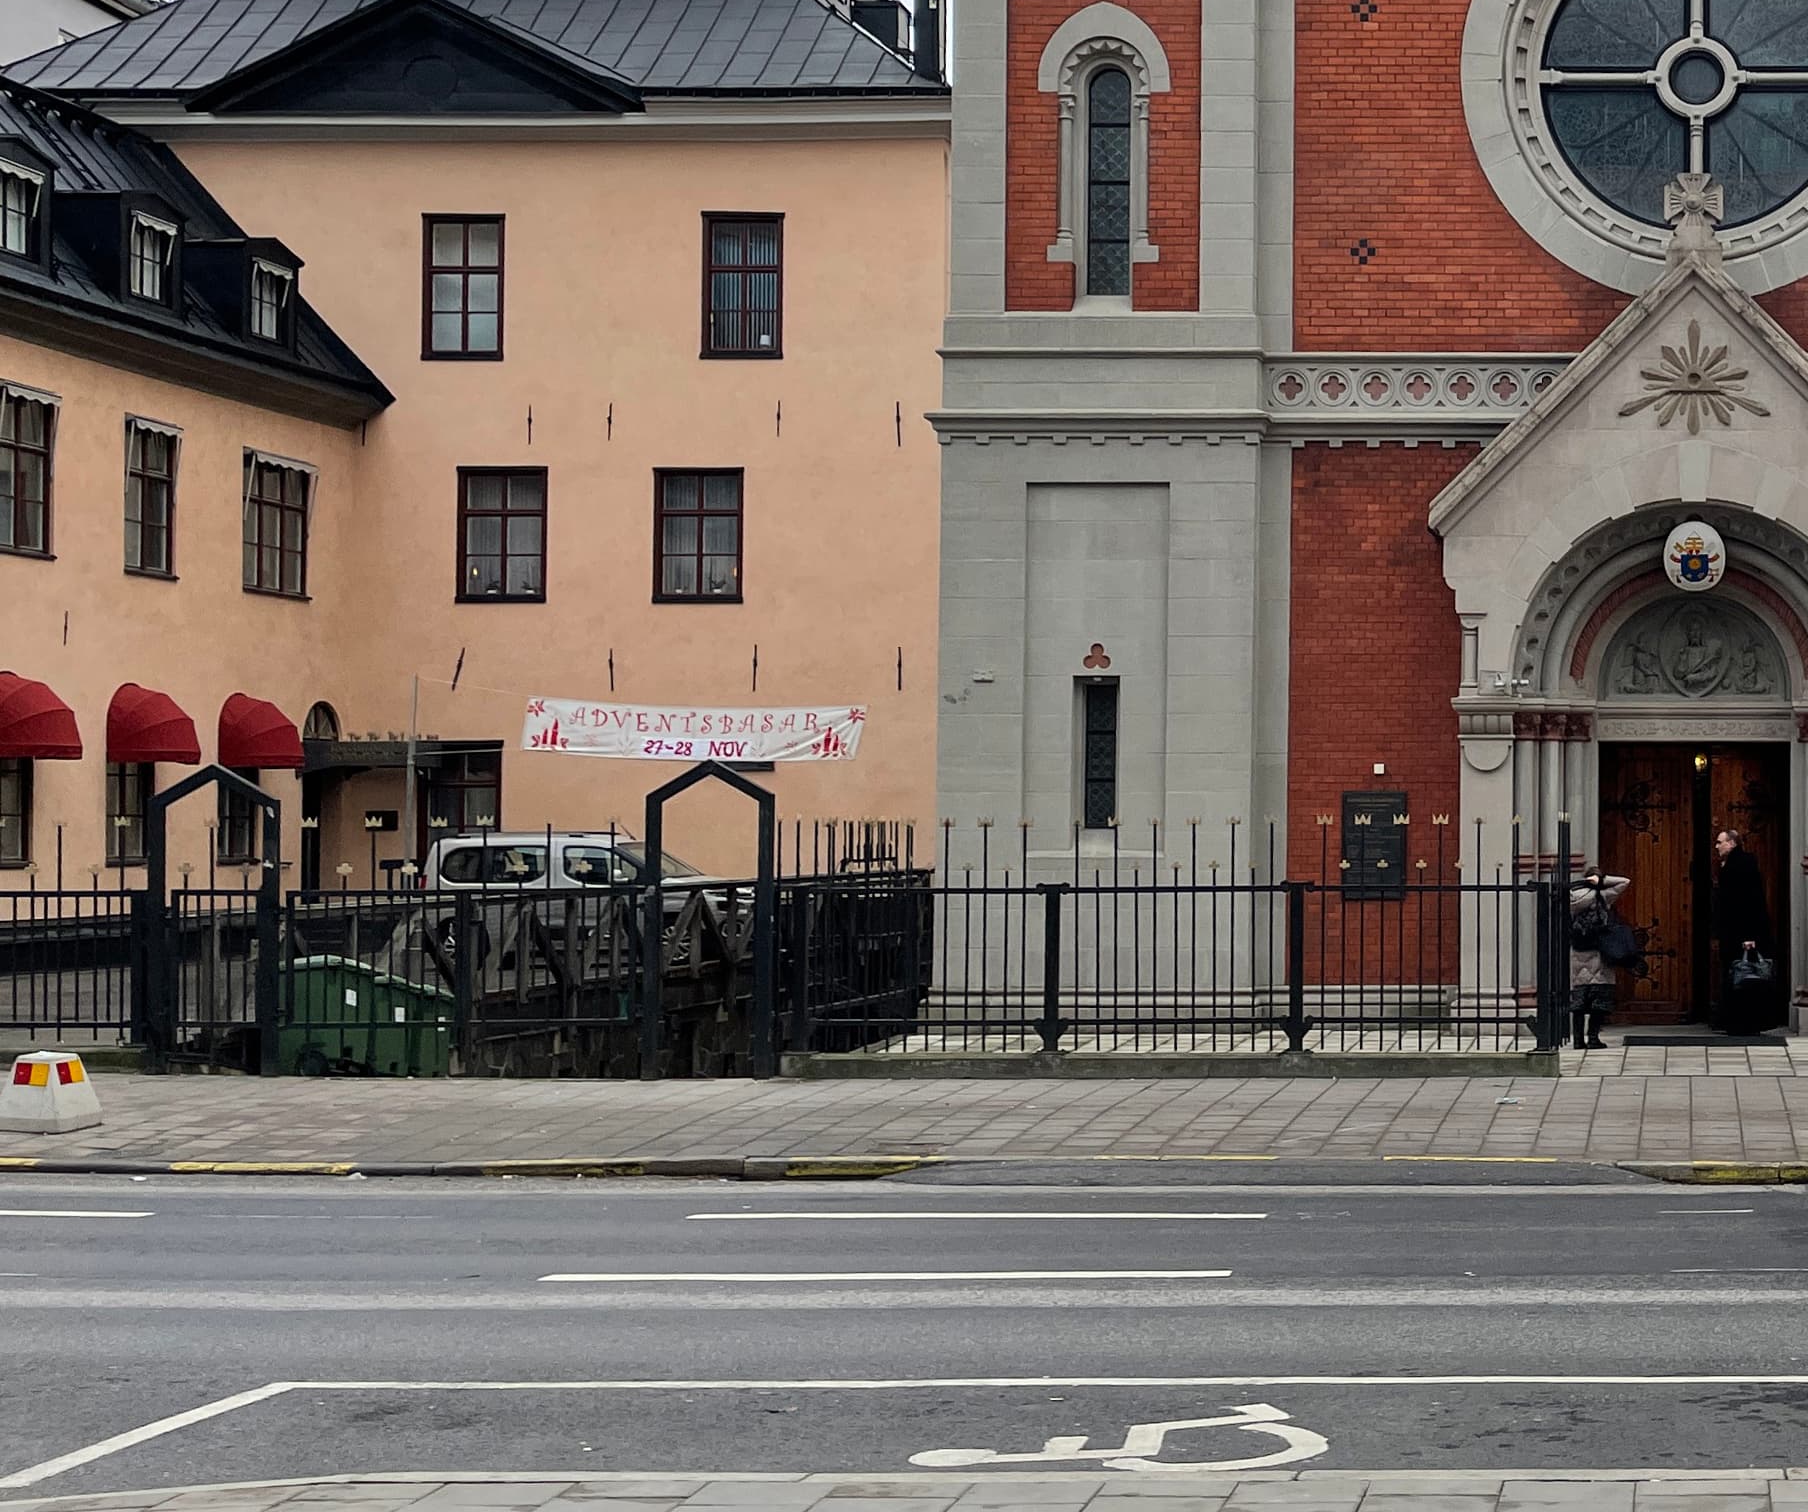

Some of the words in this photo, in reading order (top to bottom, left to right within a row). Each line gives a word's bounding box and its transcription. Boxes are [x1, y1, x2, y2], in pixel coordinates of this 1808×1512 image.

[568, 707, 821, 734] ADVENTSBASAR
[643, 740, 693, 756] 27-28
[708, 740, 747, 757] NOV
